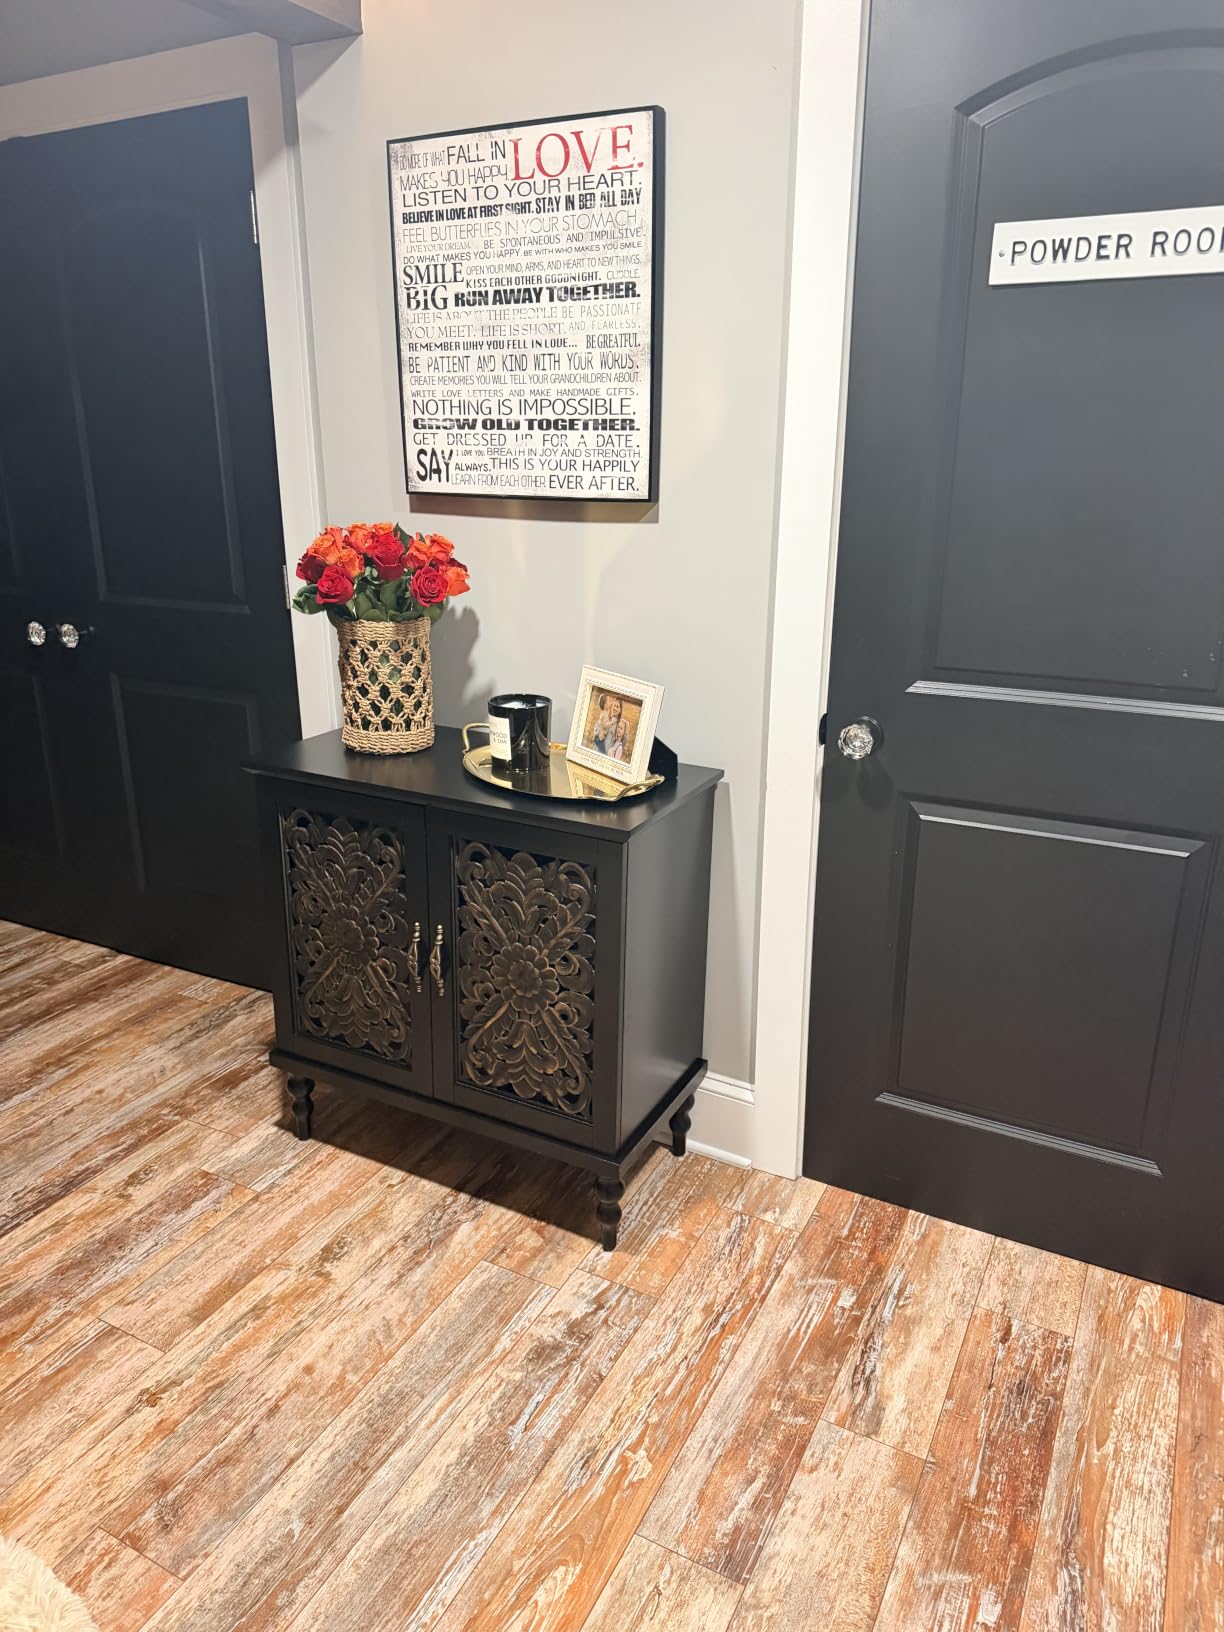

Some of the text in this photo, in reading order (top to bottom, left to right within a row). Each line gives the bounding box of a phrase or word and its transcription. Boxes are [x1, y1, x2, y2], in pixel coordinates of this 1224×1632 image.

[447, 140, 506, 166] FALL IN
[509, 124, 644, 181] LOVE.
[400, 171, 439, 192] MAKES
[441, 169, 466, 188] YOU
[402, 169, 642, 208] LISTEN TO YOUR HEART.
[535, 187, 642, 215] STAY IN BED ALL DAY
[402, 201, 535, 224] BELIEVE IN LOVE AT FIRST SIGHT.
[402, 228, 427, 245] FEEL
[430, 221, 502, 242] BUTTERFLIES
[505, 219, 520, 237] IN
[521, 216, 559, 235] YOUR
[483, 240, 496, 250] BE
[500, 233, 561, 249] SPONTANEOUS
[566, 232, 584, 243] AND
[1009, 226, 1224, 266] POWDER ROO
[403, 256, 416, 265] DO
[416, 253, 442, 264] WHAT
[442, 251, 472, 263] MAKES
[473, 250, 491, 260] YOU
[523, 249, 534, 257] BE
[534, 248, 554, 256] WITH
[554, 246, 573, 254] WHO
[574, 244, 601, 253] MAKES
[602, 242, 619, 251] YOU
[402, 262, 465, 286] SMILE
[466, 265, 485, 276] OPEN
[485, 264, 505, 275] YOUR
[547, 260, 561, 270] AND
[562, 258, 584, 270] HEART
[466, 278, 488, 289] KISS
[489, 275, 513, 287] EACH
[513, 274, 543, 286] OTHER
[404, 285, 449, 311] BIG
[454, 281, 641, 308] RUN AWAY TOGETHER.
[487, 309, 510, 321] THE
[561, 305, 574, 319] BE
[406, 326, 436, 339] YOU
[480, 324, 507, 338] LIFE
[509, 324, 519, 337] IS
[569, 319, 587, 331] AND
[408, 341, 461, 352] REMEMBER
[462, 340, 484, 351] WHY
[486, 339, 505, 350] YOU
[506, 339, 529, 350] FELL
[531, 339, 543, 350] IN
[585, 334, 597, 349] BE
[408, 350, 640, 374] BE PATIENT AND KIND WITH YOUR WORDS.
[410, 375, 436, 386] CREATE
[437, 375, 475, 386] MEMORIES
[475, 375, 491, 385] YOU
[491, 374, 508, 385] WILL
[509, 374, 527, 385] TELL
[528, 373, 549, 384] YOUR
[550, 371, 612, 384] GRANDCHILDREN
[411, 387, 639, 398] WRITE LOVE LETTERS AND MAKE HANDMADE GIFTS.
[412, 397, 637, 416] NOTHING IS IMPOSSIBLE.
[413, 417, 641, 431] GROW OLD TOGETHER.
[413, 432, 439, 446] GET
[446, 432, 507, 447] DRESSED
[542, 433, 569, 448] FOR
[577, 433, 588, 448] A
[596, 434, 641, 448] DATE.
[461, 449, 473, 457] LOVE
[527, 448, 538, 457] IN
[539, 448, 559, 458] JOY
[560, 448, 583, 458] AND
[415, 447, 454, 484] SAY
[454, 463, 492, 473] ALWAYS.
[489, 457, 641, 473] THIS IS YOUR HAPPILY
[450, 473, 476, 486] LEARN
[477, 474, 499, 487] FROM
[499, 475, 520, 488] EACH
[548, 474, 640, 492] EVER AFTER.
